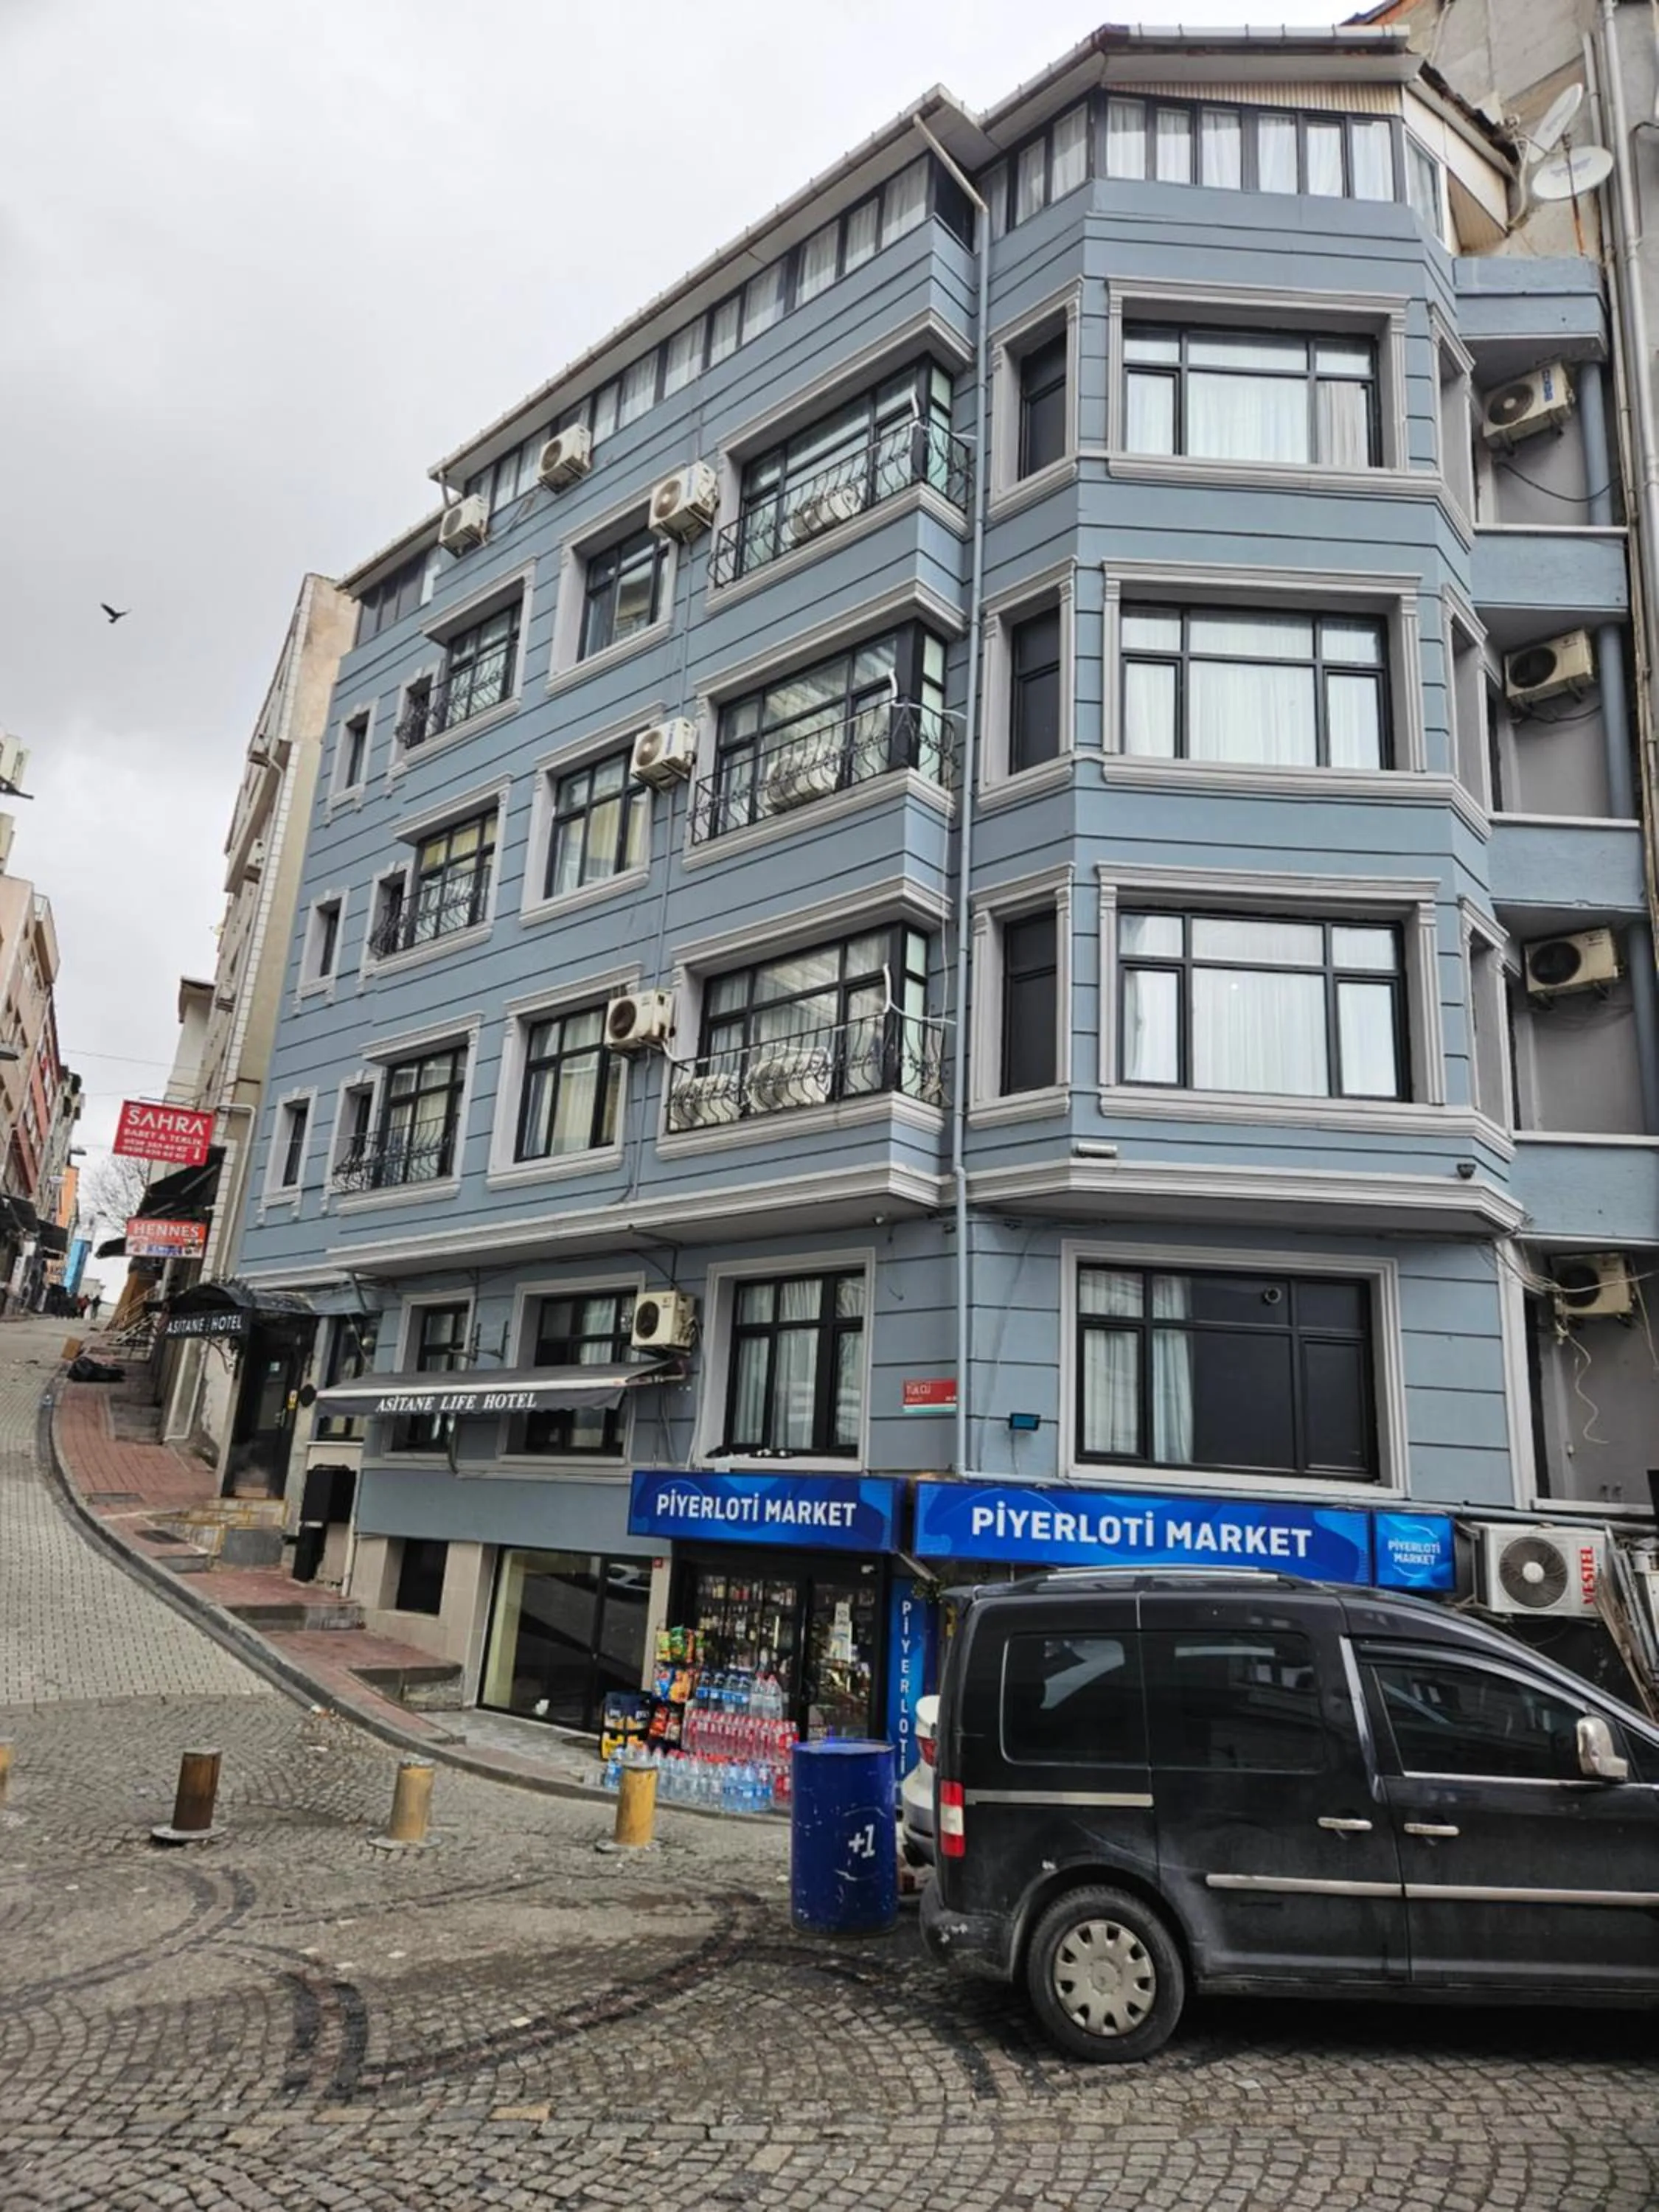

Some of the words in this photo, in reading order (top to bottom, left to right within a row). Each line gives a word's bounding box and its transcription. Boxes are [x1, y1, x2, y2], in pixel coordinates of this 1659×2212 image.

[133, 1223, 199, 1238] HENNES
[211, 1315, 242, 1330] HOTEL
[439, 1394, 477, 1411] LIFE
[483, 1392, 537, 1409] HOTEL
[656, 1489, 759, 1521] PİYERLOTİ
[765, 1498, 857, 1526] MARKET
[972, 1500, 1154, 1547] PİYERLOTİ
[1166, 1520, 1312, 1558] MARKET
[1394, 1553, 1436, 1565] MARKET
[1580, 1545, 1595, 1604] VESTEL
[848, 1824, 875, 1858] +1
